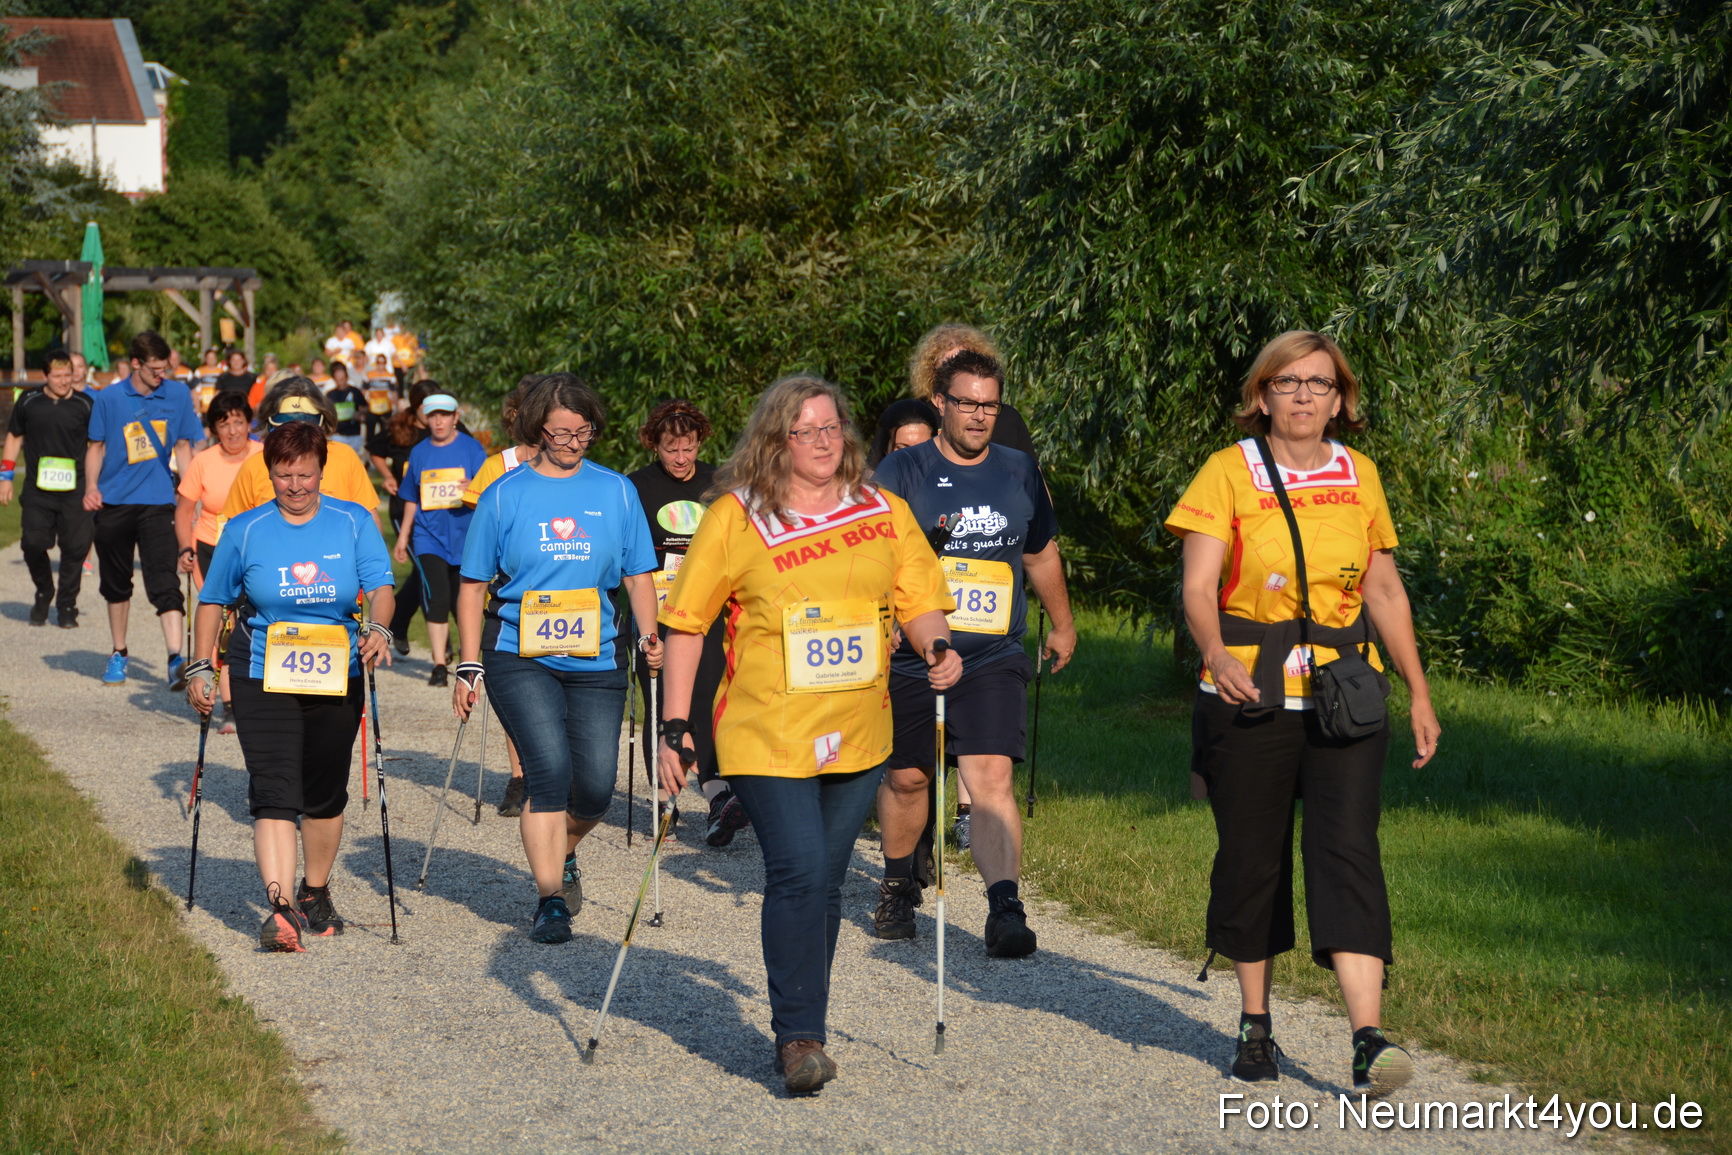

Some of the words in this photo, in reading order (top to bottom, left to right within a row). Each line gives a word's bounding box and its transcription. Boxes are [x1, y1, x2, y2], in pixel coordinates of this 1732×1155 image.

[42, 470, 73, 483] 1200
[429, 484, 457, 498] 782
[1258, 496, 1307, 510] MX
[1312, 489, 1361, 506] BÖGL
[538, 522, 550, 542] I
[540, 539, 591, 554] camping
[944, 540, 968, 551] eil's
[973, 536, 1003, 551] guad
[571, 554, 591, 562] Berger
[772, 538, 838, 574] MAX
[278, 567, 290, 587] I
[280, 583, 336, 597] camping
[952, 587, 997, 614] 183
[536, 617, 585, 640] 494
[806, 635, 863, 667] 895
[281, 651, 332, 675] 493
[815, 671, 840, 680] Gabriele
